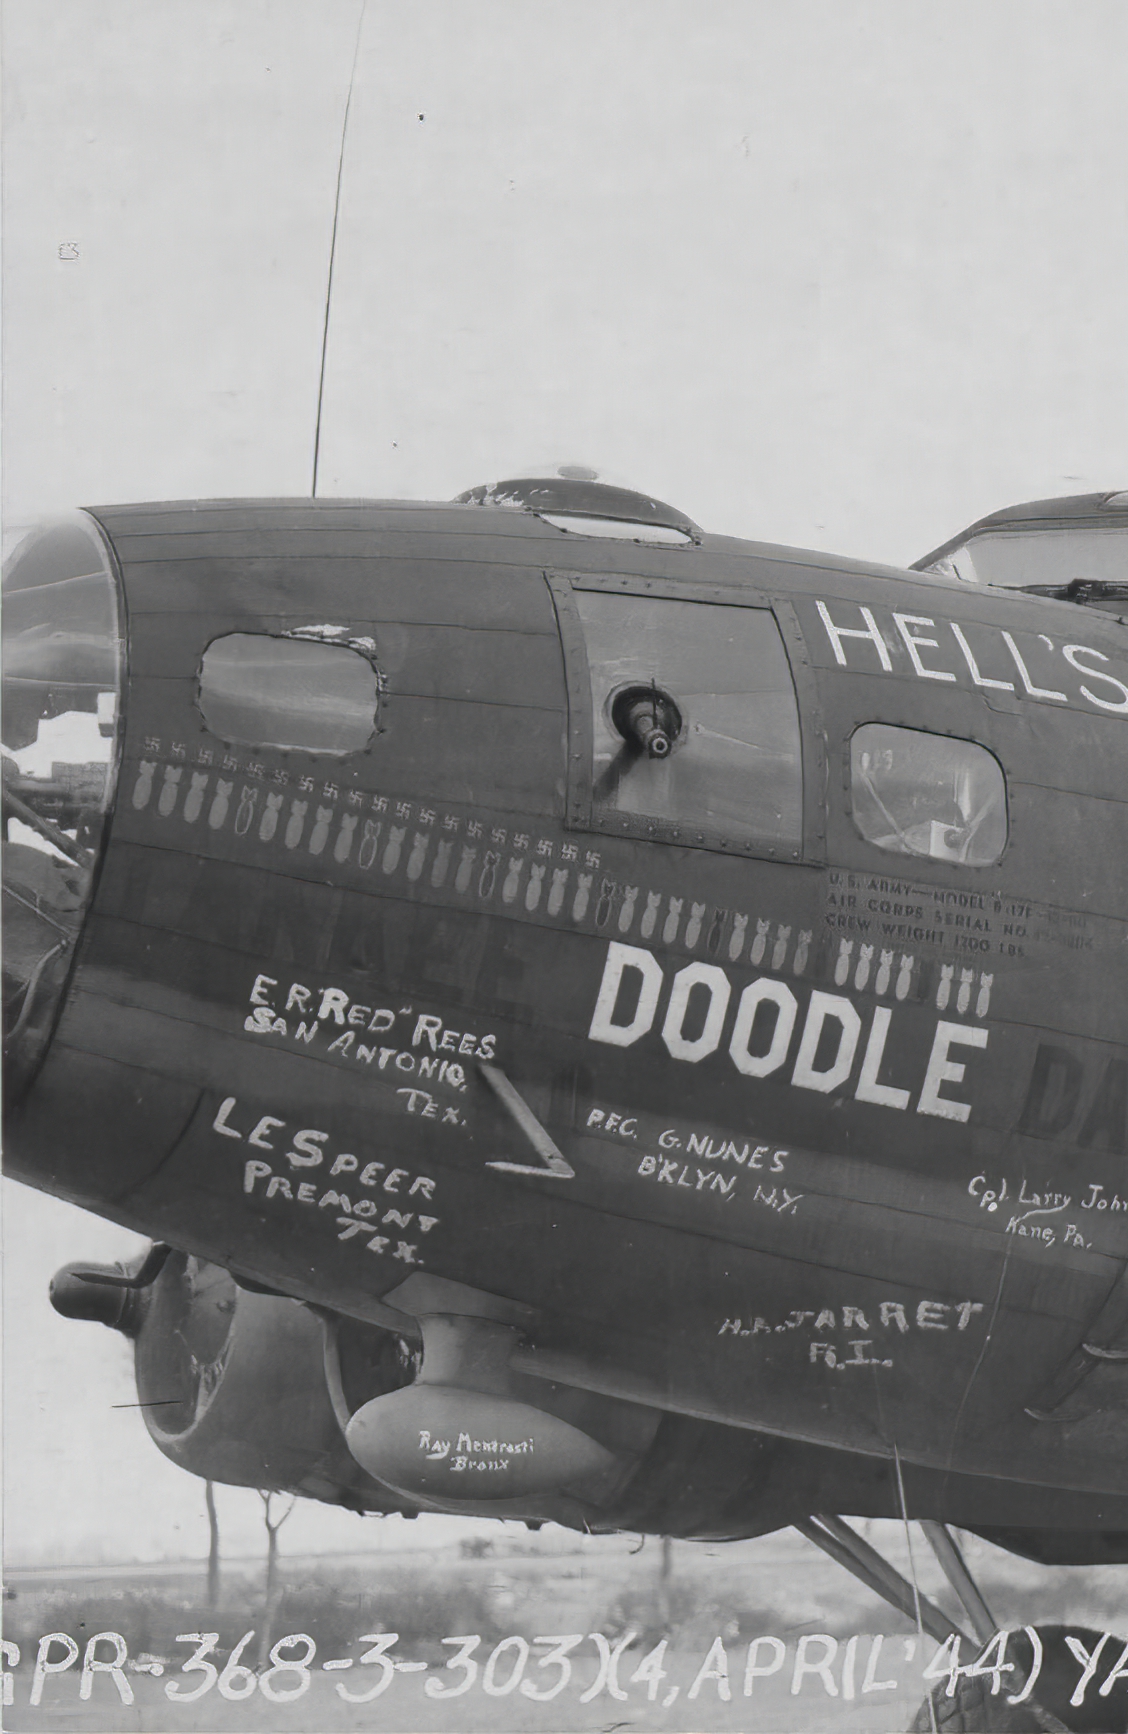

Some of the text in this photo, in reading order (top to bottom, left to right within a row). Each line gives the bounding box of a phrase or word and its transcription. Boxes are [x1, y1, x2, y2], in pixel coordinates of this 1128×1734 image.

[827, 892, 857, 908] AIR
[867, 898, 924, 919] CORPS
[825, 912, 871, 932] CREW
[881, 923, 945, 944] WEIGHT
[588, 940, 990, 1124] DOODLE
[449, 1455, 509, 1472] Bronx
